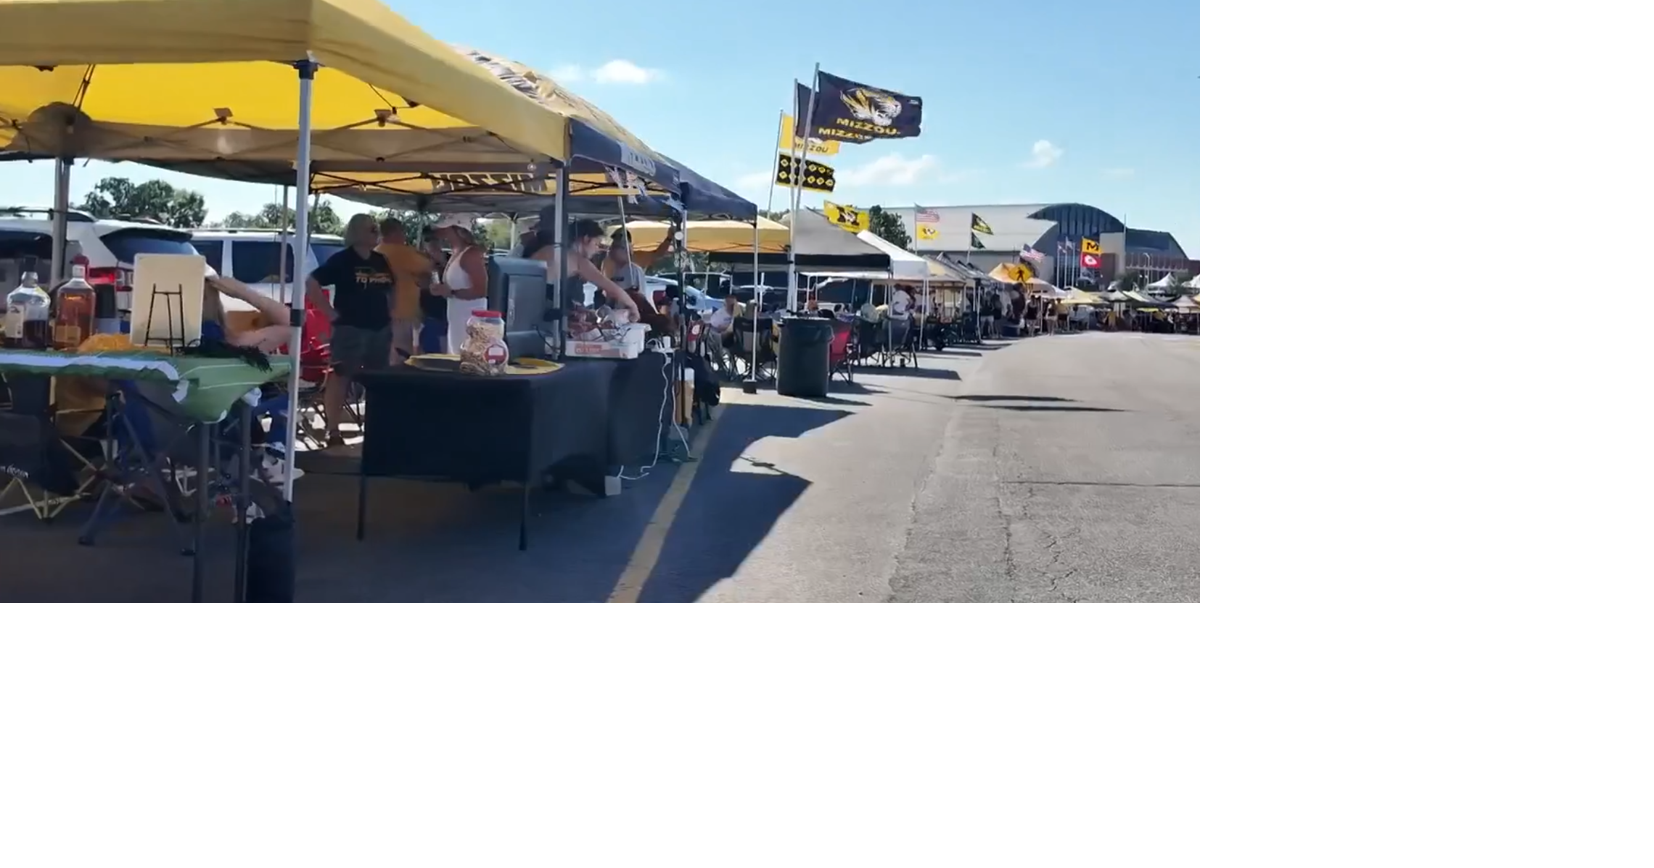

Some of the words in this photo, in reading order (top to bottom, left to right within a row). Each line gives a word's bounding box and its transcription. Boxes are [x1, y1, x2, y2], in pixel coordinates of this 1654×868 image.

[836, 117, 898, 135] MIZZOU
[818, 127, 873, 140] MIZZ
[1086, 242, 1099, 251] M
